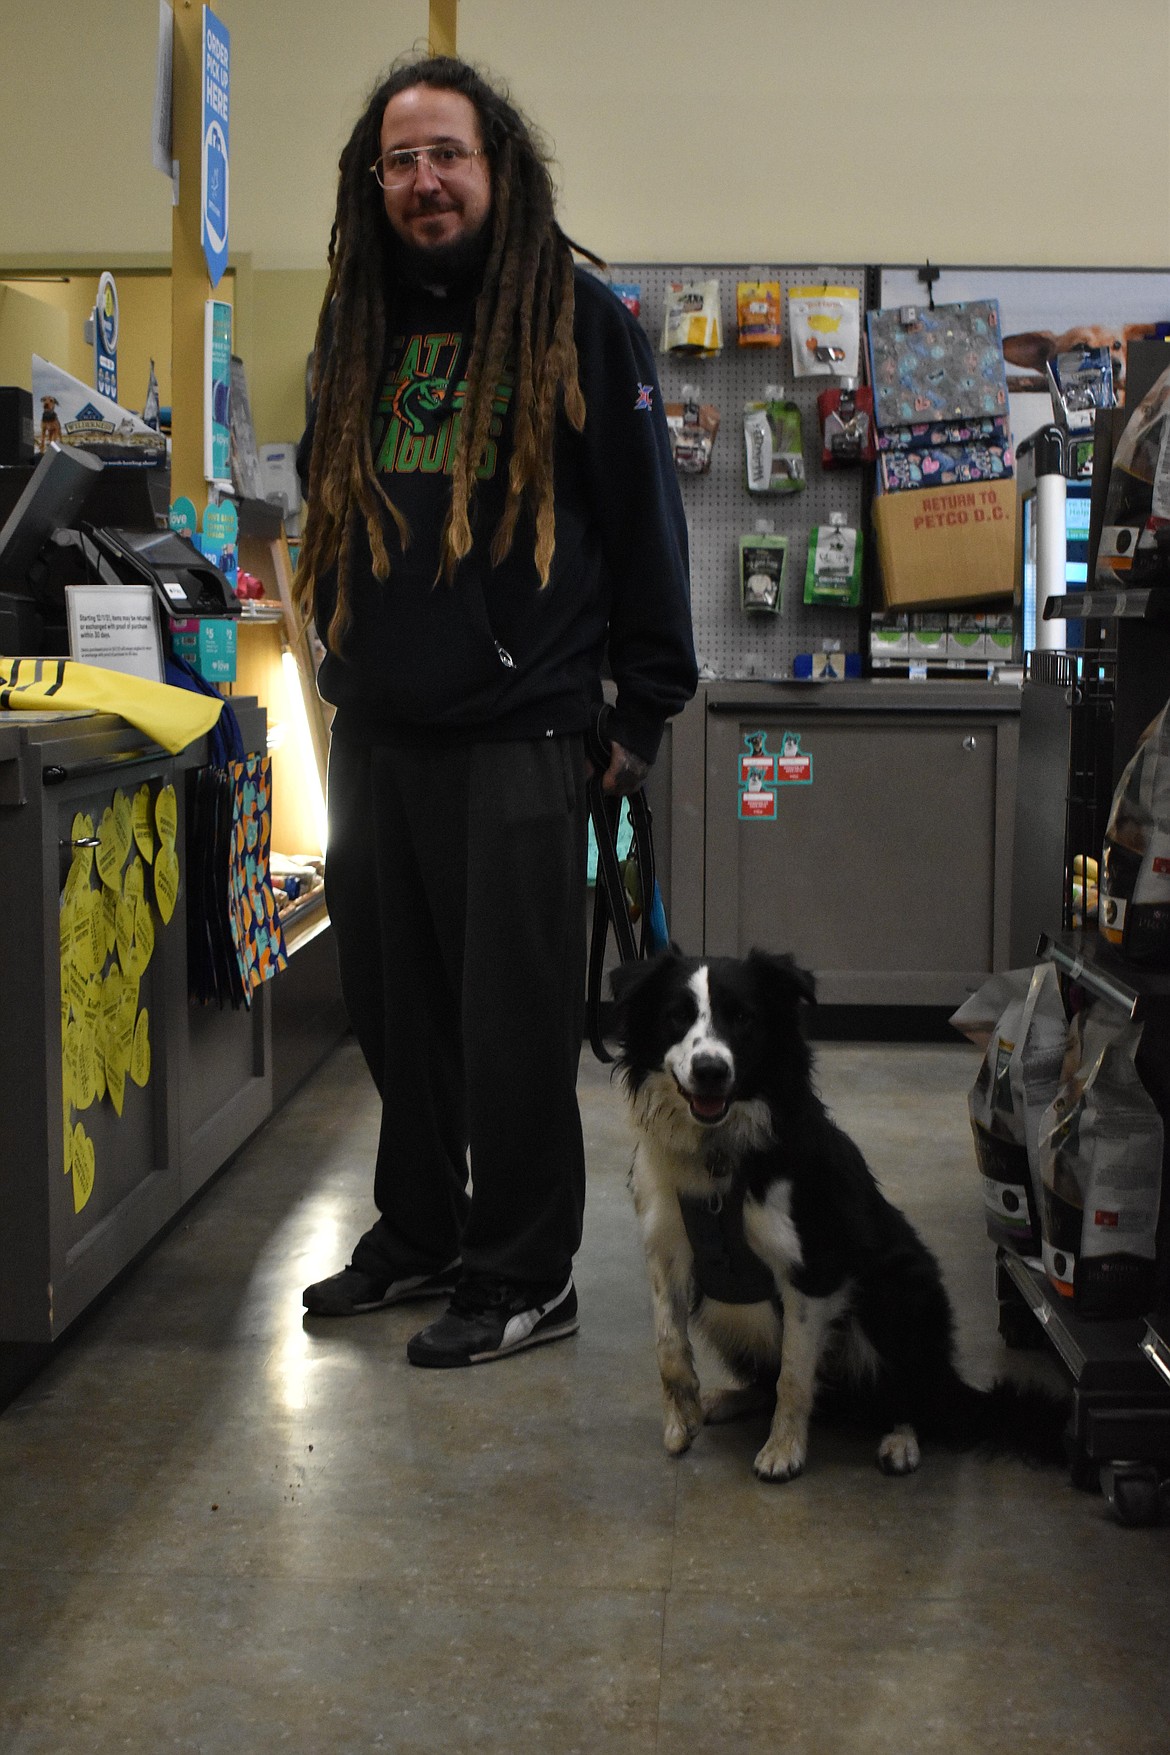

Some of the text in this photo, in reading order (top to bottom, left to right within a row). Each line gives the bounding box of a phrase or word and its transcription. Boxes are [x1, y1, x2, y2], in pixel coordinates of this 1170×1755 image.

[207, 28, 229, 70] ORDER
[207, 52, 229, 89] PICK UP
[206, 75, 229, 122] HERE
[67, 420, 113, 433] WILDERNESS
[922, 490, 997, 512] RETURN TO
[913, 506, 1010, 530] PETCO D.C.
